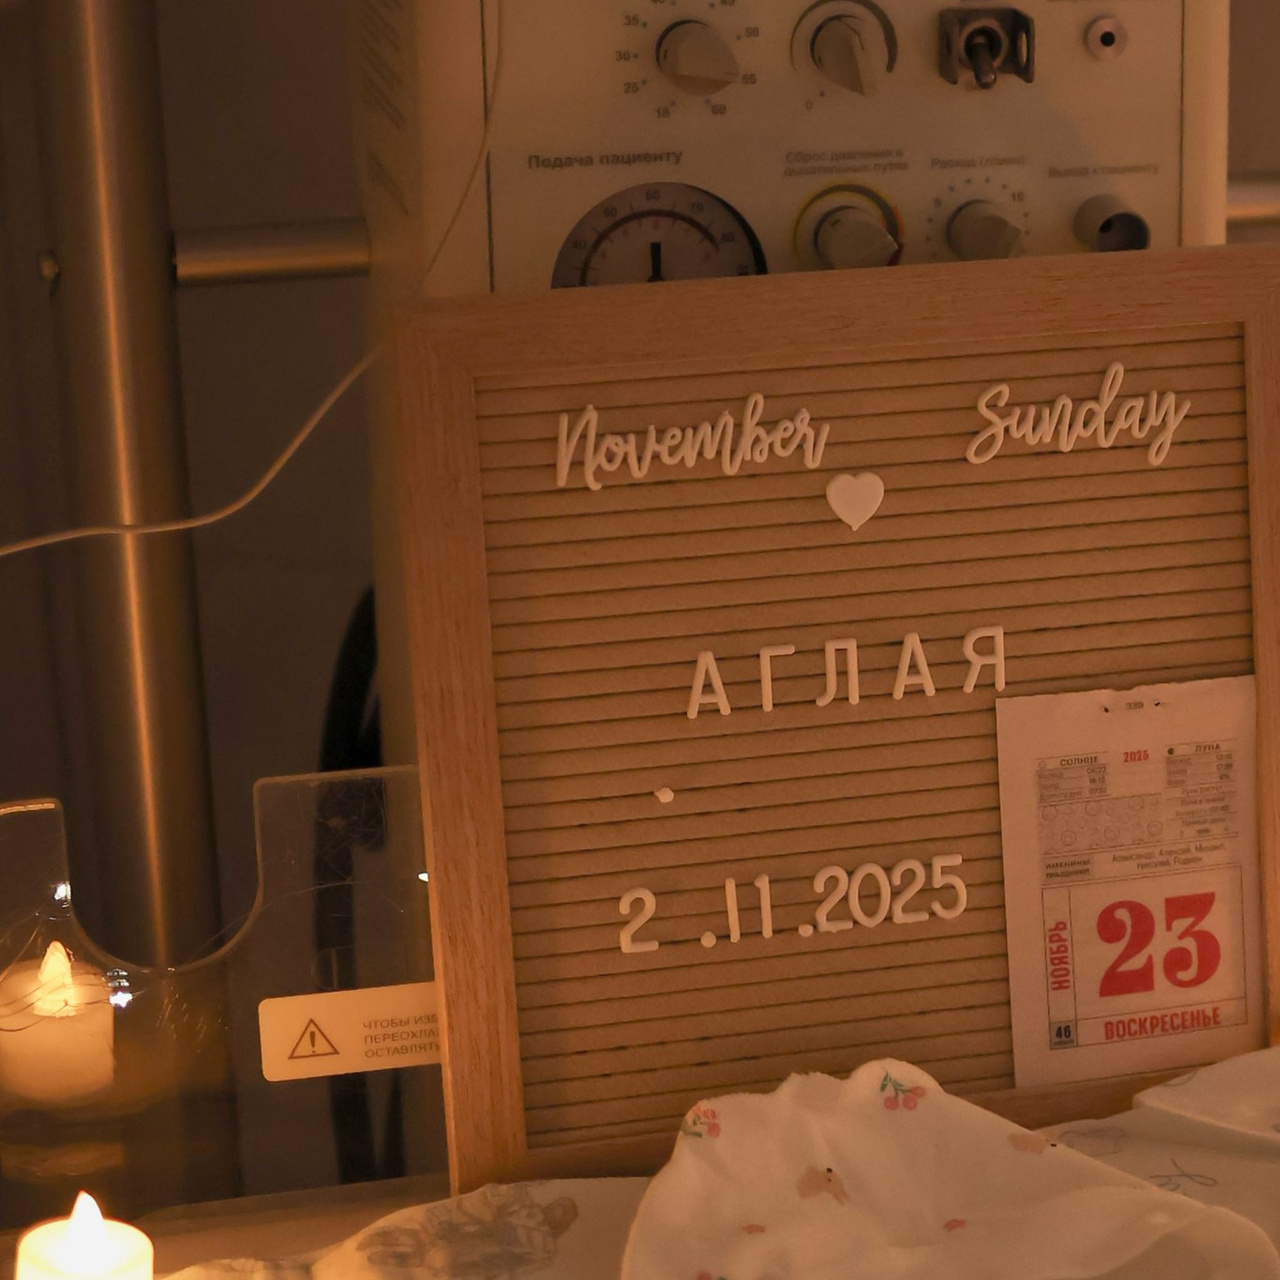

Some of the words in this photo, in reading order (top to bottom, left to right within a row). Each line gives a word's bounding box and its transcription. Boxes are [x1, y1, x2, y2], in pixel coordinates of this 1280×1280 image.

[624, 15, 639, 26] 35
[616, 50, 631, 62] 30
[528, 154, 594, 171] Подача
[600, 150, 685, 166] пациенту
[964, 361, 1192, 466] Sunday
[555, 392, 831, 491] November
[686, 624, 1007, 720] АГЛАЯ
[1059, 755, 1099, 768] СОЛНЦЕ
[1123, 749, 1150, 764] 2025
[1096, 891, 1221, 998] 23
[1049, 920, 1070, 992] НОЯБРЬ
[363, 1018, 410, 1030] ЧТОБЫ
[1054, 1025, 1072, 1039] 46
[1103, 1006, 1221, 1041] ВОСКРЕСЕНЬЕ
